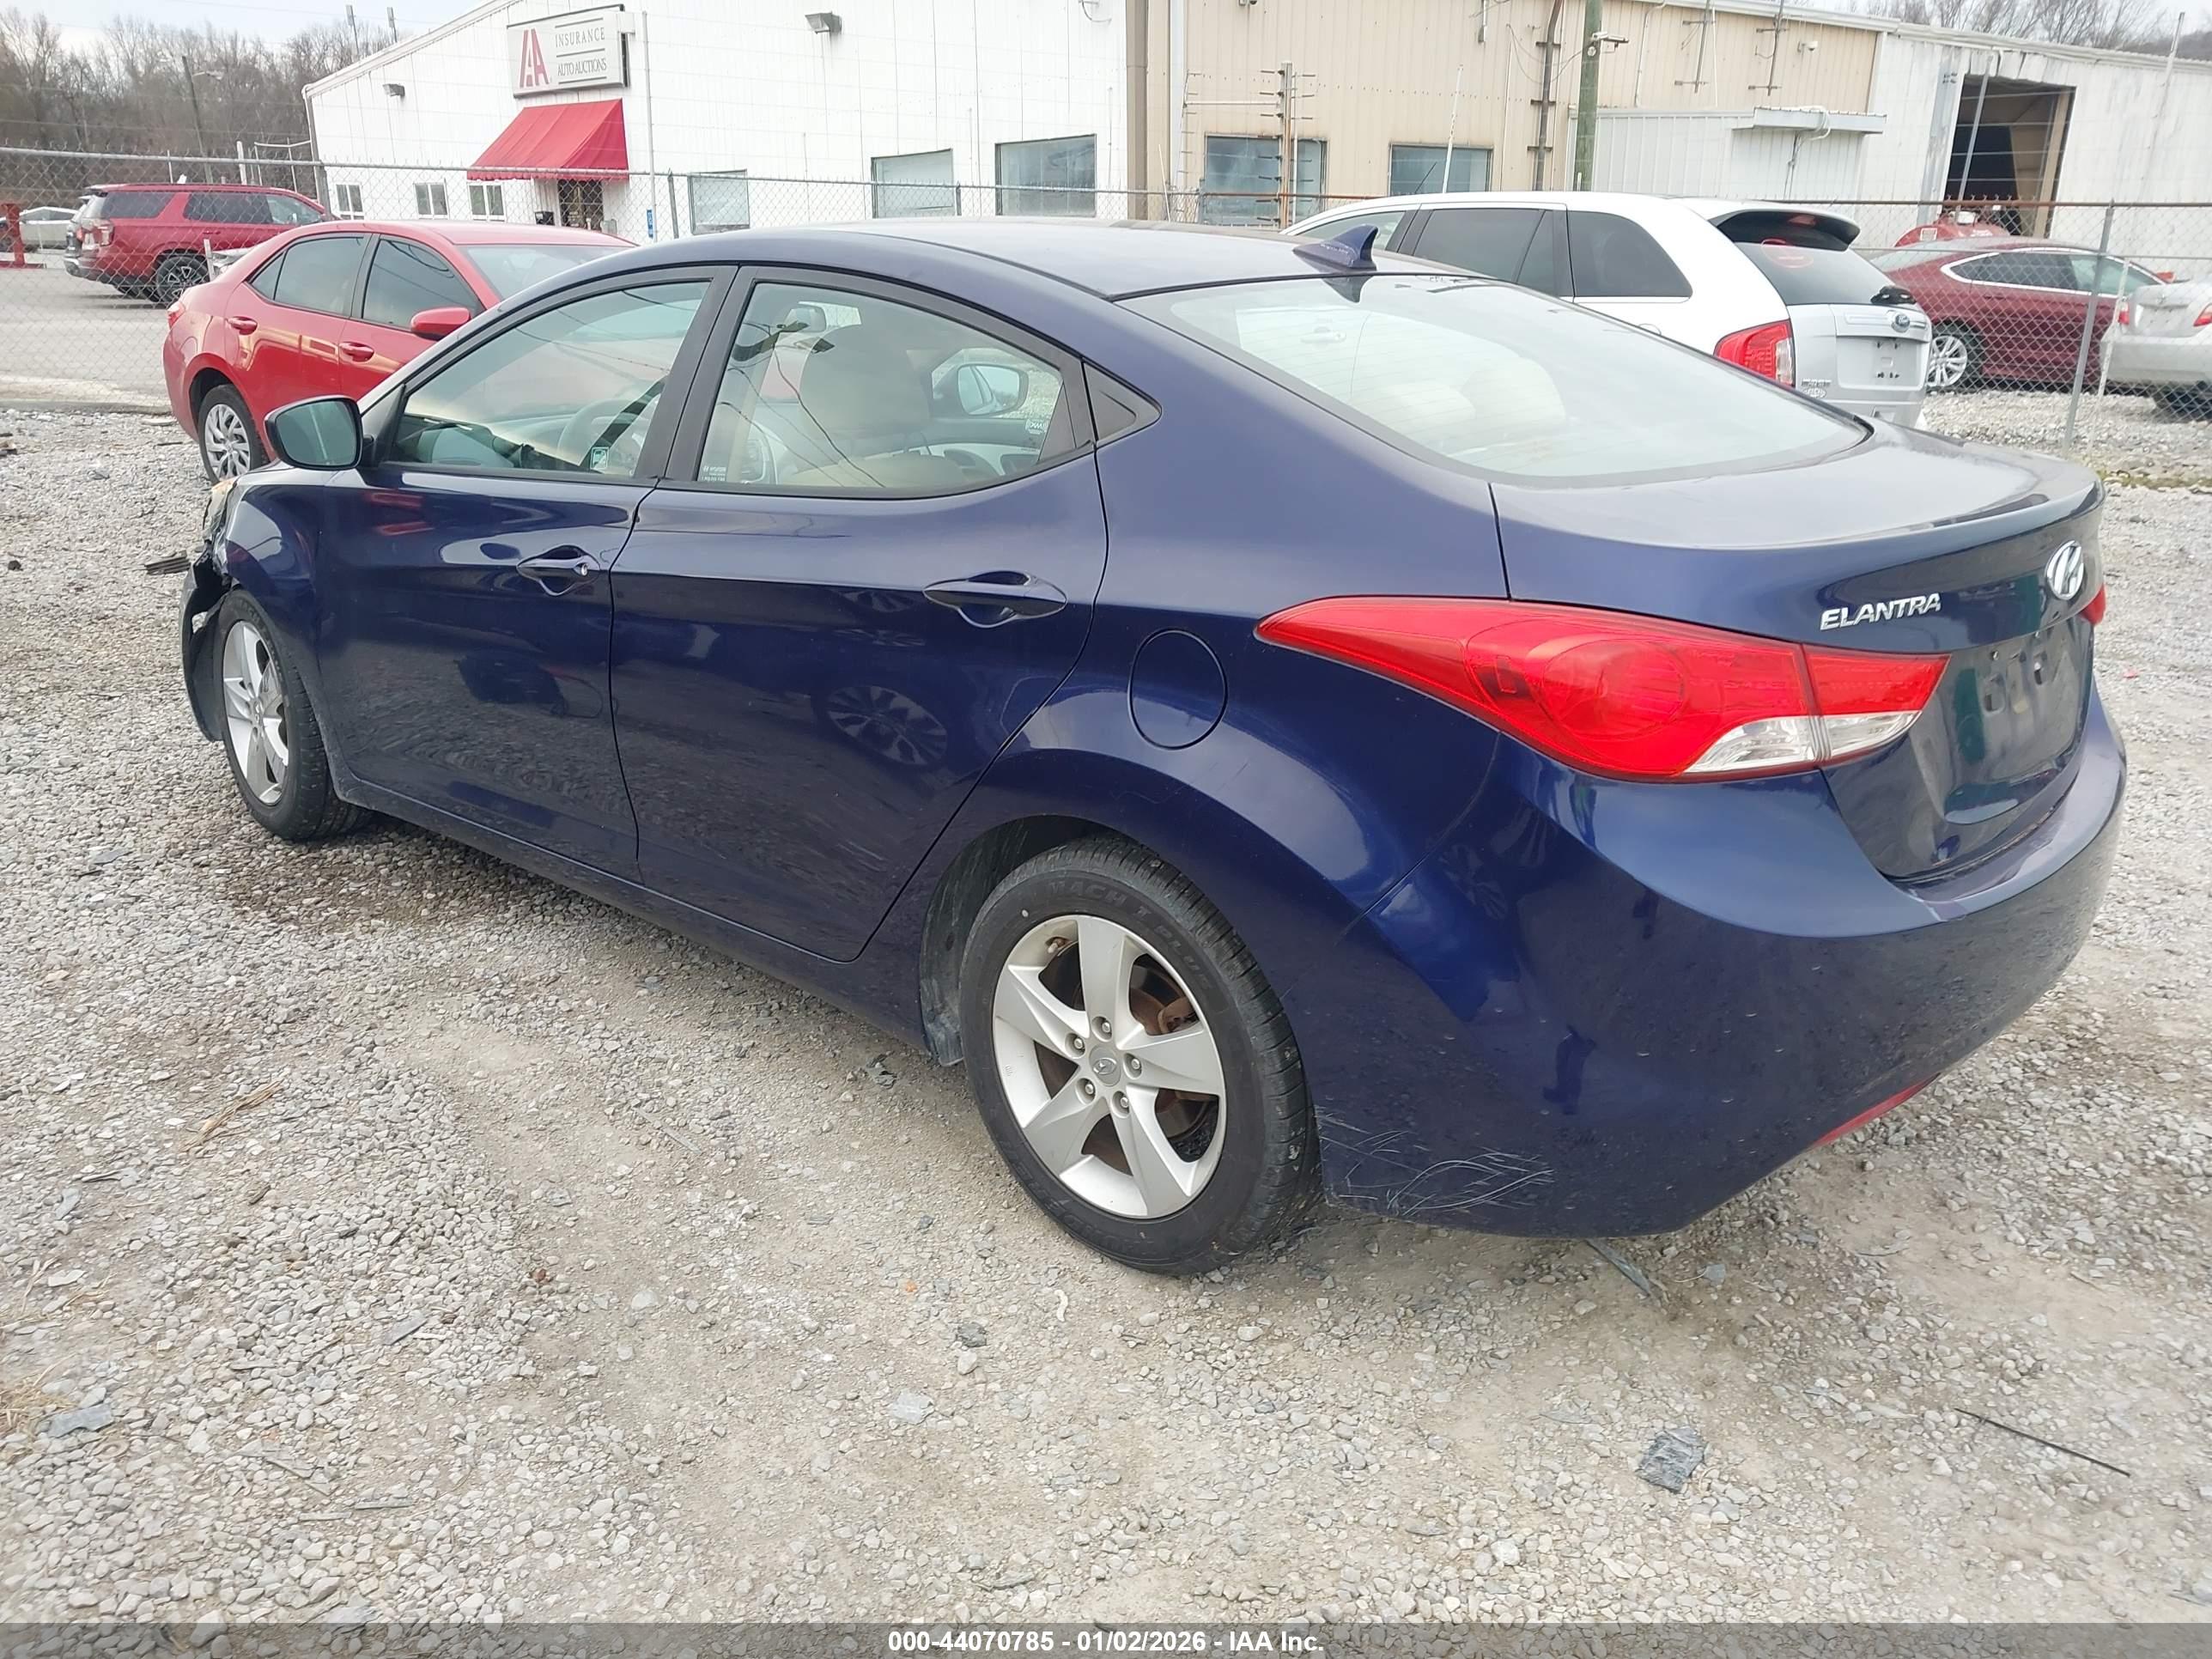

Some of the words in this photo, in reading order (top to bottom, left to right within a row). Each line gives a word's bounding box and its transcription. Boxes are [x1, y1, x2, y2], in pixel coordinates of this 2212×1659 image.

[555, 27, 605, 47] INSURANCE
[557, 61, 574, 76] AUTO
[574, 57, 607, 74] AUCTIONS
[1820, 592, 1942, 631] ELANTRA
